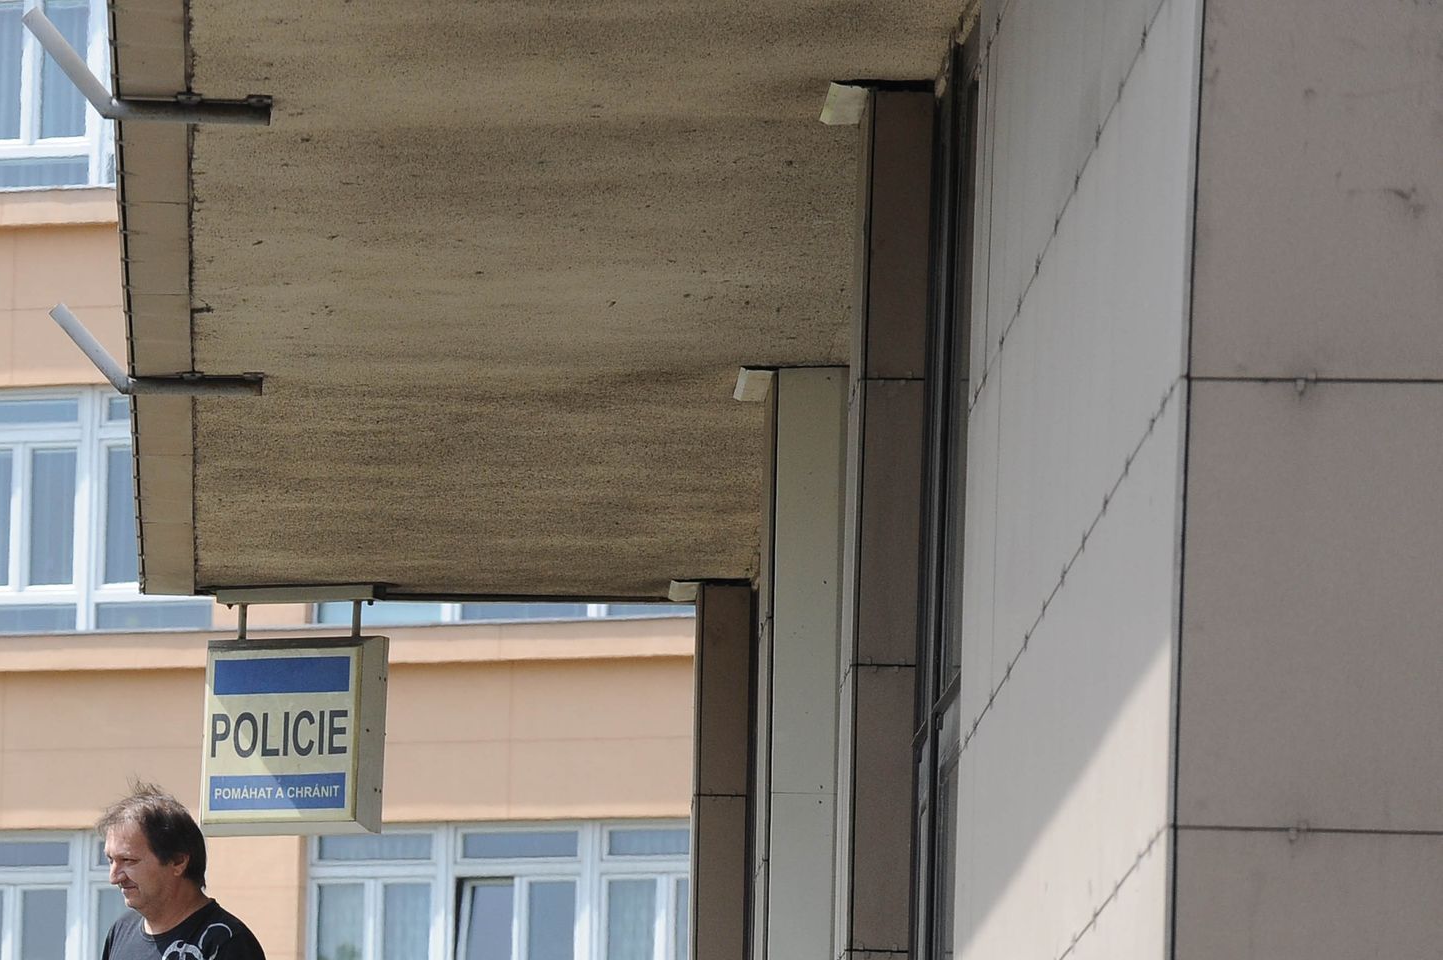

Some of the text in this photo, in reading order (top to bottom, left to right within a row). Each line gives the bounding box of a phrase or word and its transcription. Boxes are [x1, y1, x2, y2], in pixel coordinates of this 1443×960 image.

[210, 709, 349, 759] POLICIE
[214, 783, 340, 800] POMÁHAT A CHRÁNIT
